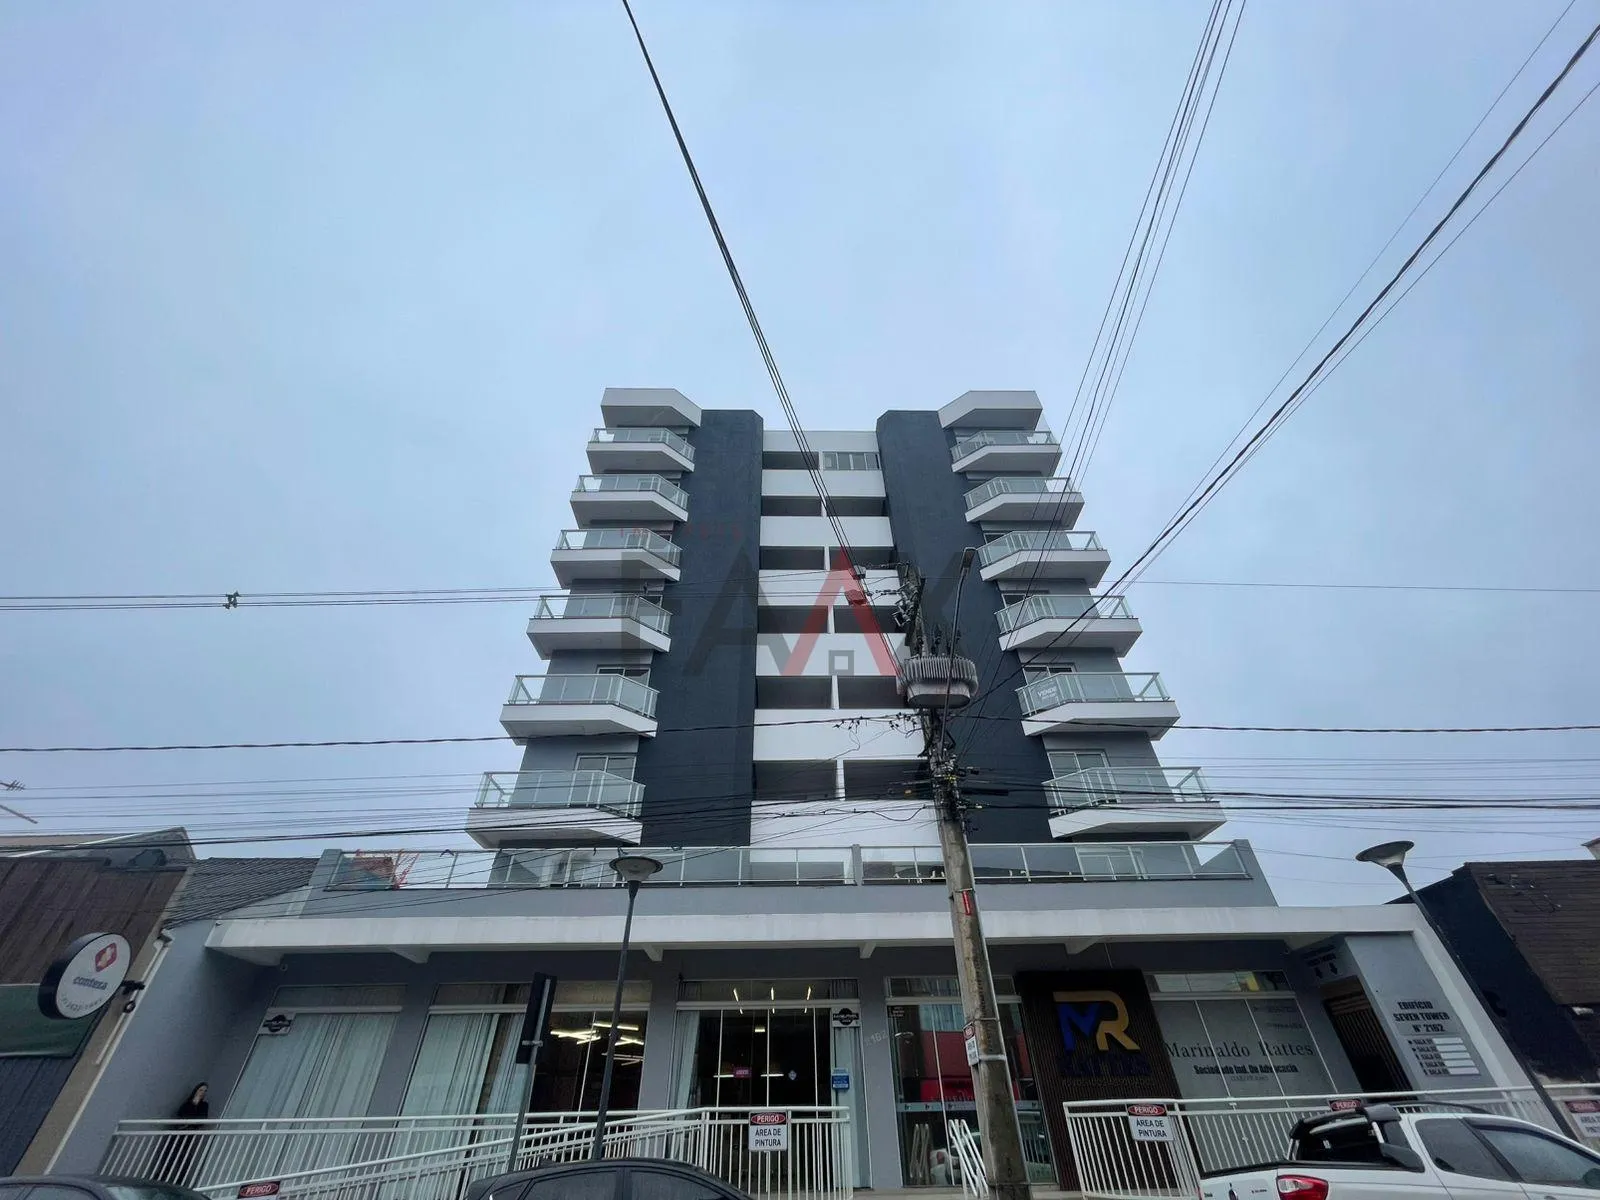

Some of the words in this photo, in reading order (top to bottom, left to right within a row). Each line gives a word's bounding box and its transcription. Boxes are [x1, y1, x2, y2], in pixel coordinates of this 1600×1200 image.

[1393, 1013, 1419, 1021] SEVEN
[1419, 1012, 1450, 1020] TOWER
[1164, 1040, 1250, 1058] Marinaldo
[1134, 1106, 1159, 1114] PERIGO
[757, 1114, 779, 1123] PERIGO
[1155, 1119, 1164, 1127] DE
[755, 1127, 772, 1136] ÁREA
[773, 1127, 781, 1136] DE
[1138, 1129, 1168, 1138] PINTURA
[755, 1138, 781, 1147] PINTURA
